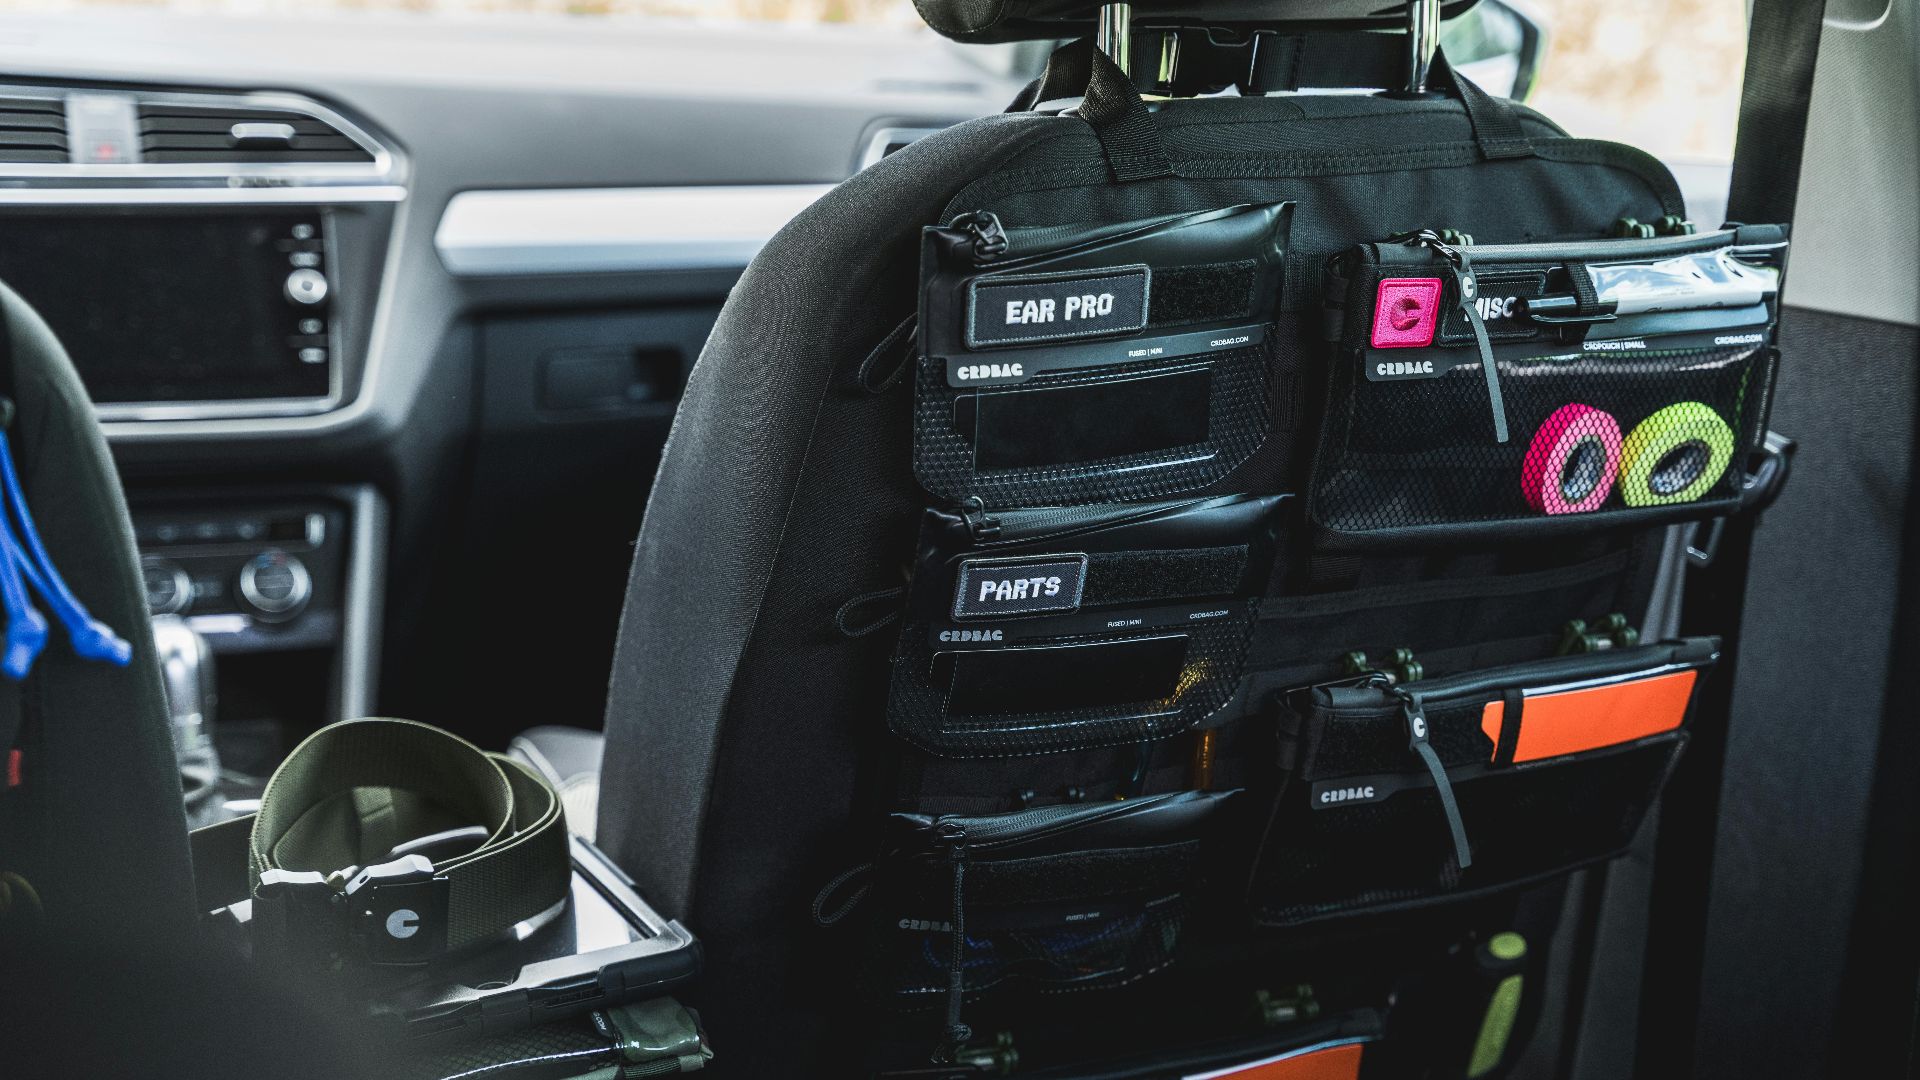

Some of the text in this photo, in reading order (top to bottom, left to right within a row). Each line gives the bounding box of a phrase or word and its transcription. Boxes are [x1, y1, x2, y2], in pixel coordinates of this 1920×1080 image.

[1005, 293, 1115, 325] EAR PRO
[957, 363, 1024, 380] CRDBAG
[1376, 360, 1434, 376] CRDBAG
[978, 576, 1061, 602] PARTS
[939, 629, 1003, 643] CRDBAG
[1320, 785, 1375, 803] CRDBAG
